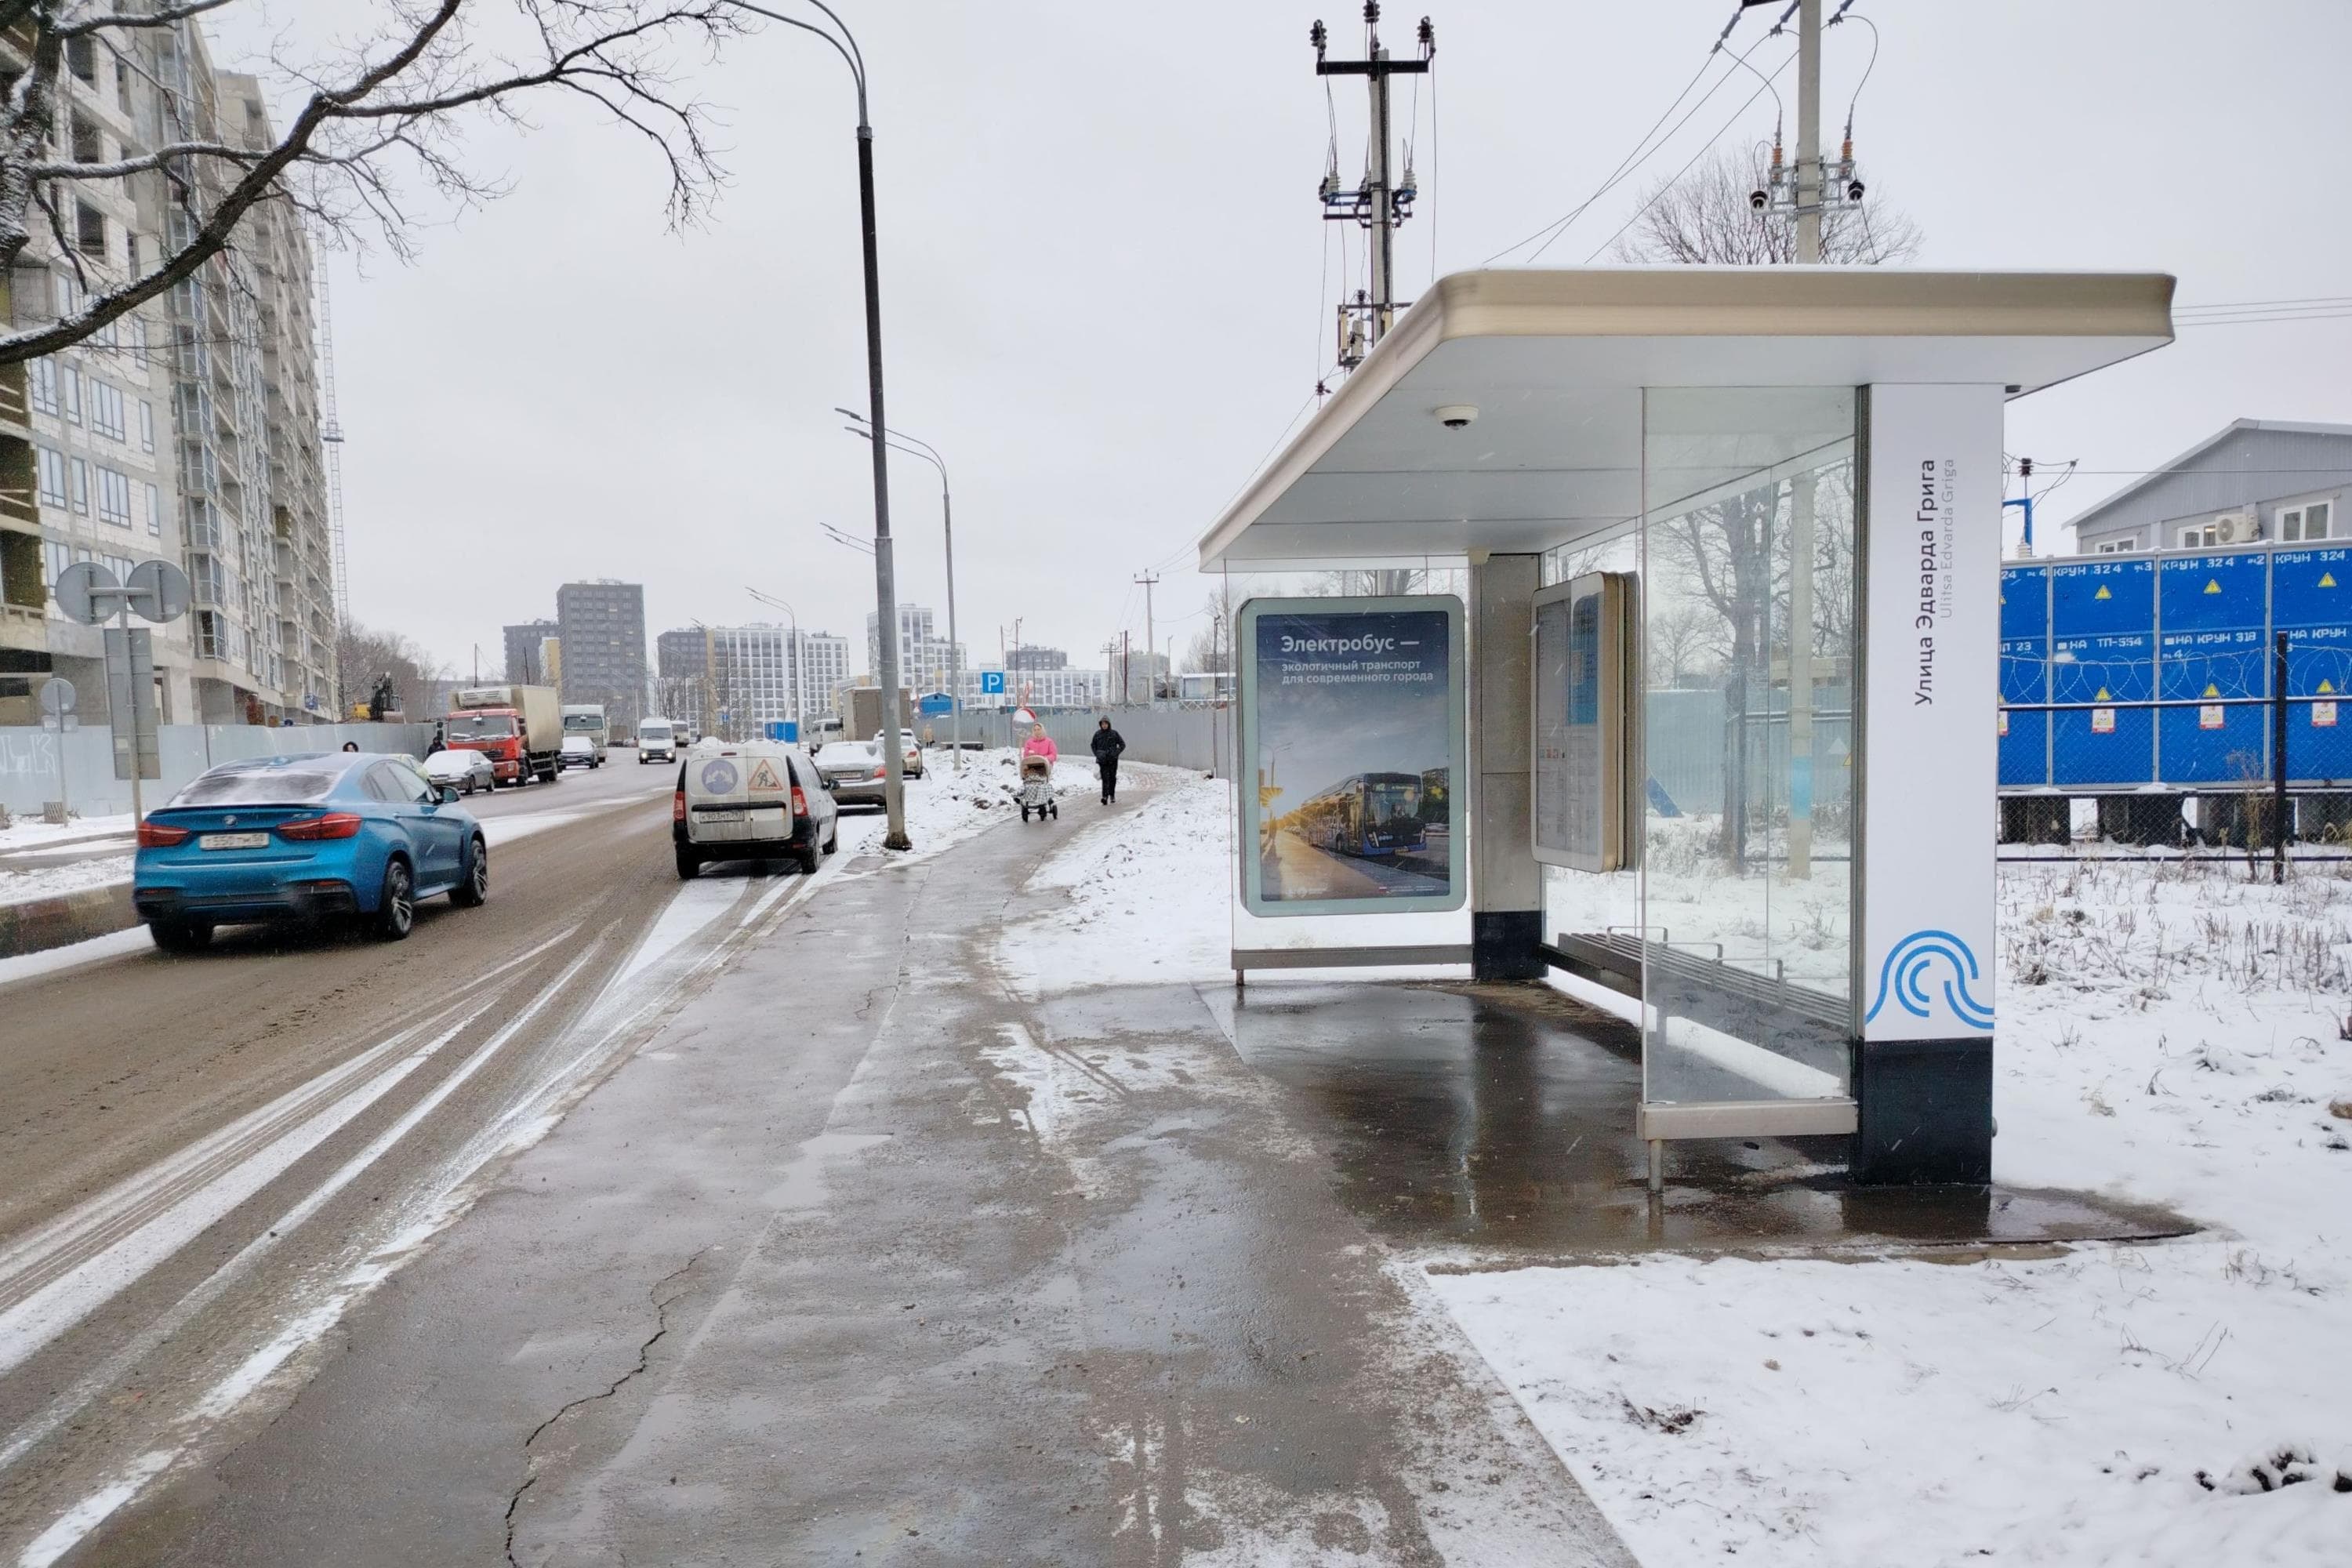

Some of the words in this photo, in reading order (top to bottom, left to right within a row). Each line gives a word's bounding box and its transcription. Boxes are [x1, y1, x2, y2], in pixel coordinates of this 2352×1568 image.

[1941, 459, 1957, 503] Griga
[1917, 459, 1938, 521] Грига
[1940, 506, 1955, 570] Edvarda
[2161, 560, 2199, 572] КРУН
[2206, 557, 2234, 568] 324
[2275, 553, 2311, 564] КРУН
[2319, 550, 2346, 561] 324
[2053, 565, 2086, 577] КРУН
[2092, 563, 2122, 575] 324
[1915, 530, 1938, 630] Эдварда
[1940, 573, 1953, 619] Ulitsa
[2175, 634, 2194, 645] НА
[2197, 633, 2230, 644] КРУН
[2235, 631, 2257, 643] 318
[2289, 630, 2307, 640] НА
[2312, 628, 2347, 640] КРУН
[1280, 633, 1395, 655] Электробус
[2016, 641, 2032, 652] 23
[2069, 640, 2087, 650] НА
[2096, 637, 2143, 648] ТП-554
[1281, 660, 1359, 673] экологичный
[1360, 660, 1421, 673] транспорт
[1915, 637, 1936, 706] Улица
[987, 674, 1000, 691] P
[1282, 674, 1304, 685] для
[1306, 673, 1391, 685] современного
[1393, 672, 1434, 683] города
